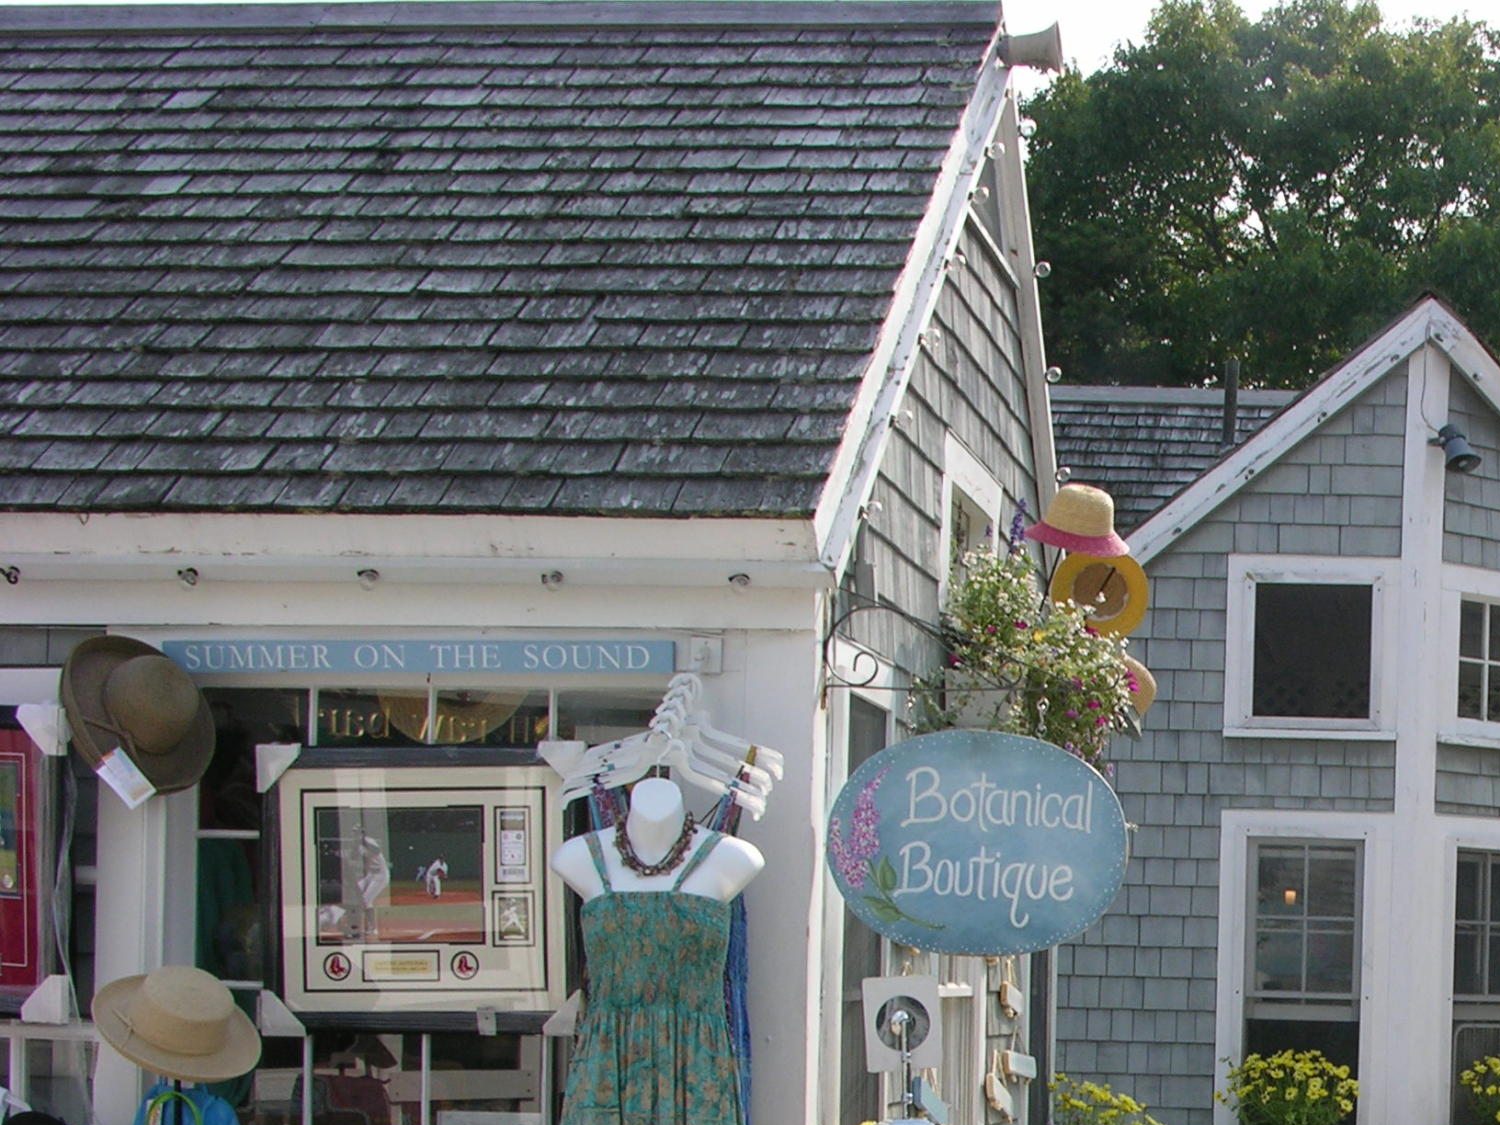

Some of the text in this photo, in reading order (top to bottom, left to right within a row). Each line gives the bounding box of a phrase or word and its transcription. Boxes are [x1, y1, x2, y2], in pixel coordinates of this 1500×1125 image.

[186, 644, 651, 670] SUMMER ON THE SOUND
[900, 766, 1093, 833] Botanical
[893, 841, 1075, 928] Boutique
